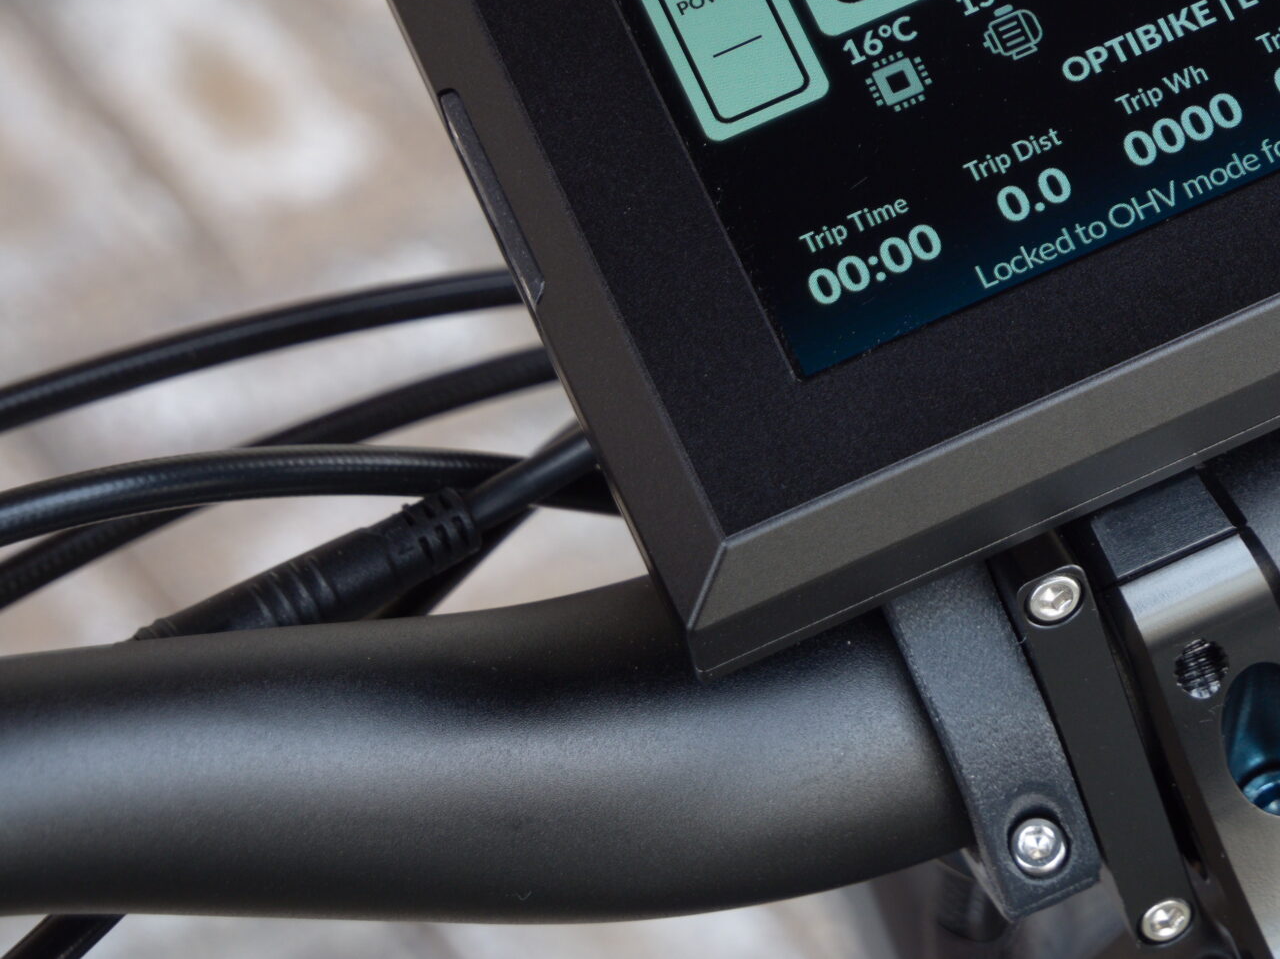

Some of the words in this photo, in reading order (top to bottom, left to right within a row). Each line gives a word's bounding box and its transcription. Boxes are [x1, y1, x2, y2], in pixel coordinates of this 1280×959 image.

[1114, 82, 1165, 117] Trip
[1161, 65, 1210, 95] Wh
[962, 149, 1012, 183] Trip
[1012, 127, 1063, 162] Dist
[1122, 92, 1243, 166] 0000
[974, 230, 1077, 290] Locked
[1076, 219, 1108, 244] to
[1107, 181, 1176, 230] OHV
[1182, 150, 1262, 198] mode
[996, 167, 1072, 222] 0.0
[799, 222, 849, 255] Trip
[847, 196, 910, 235] Time
[807, 224, 943, 305] 00:00
